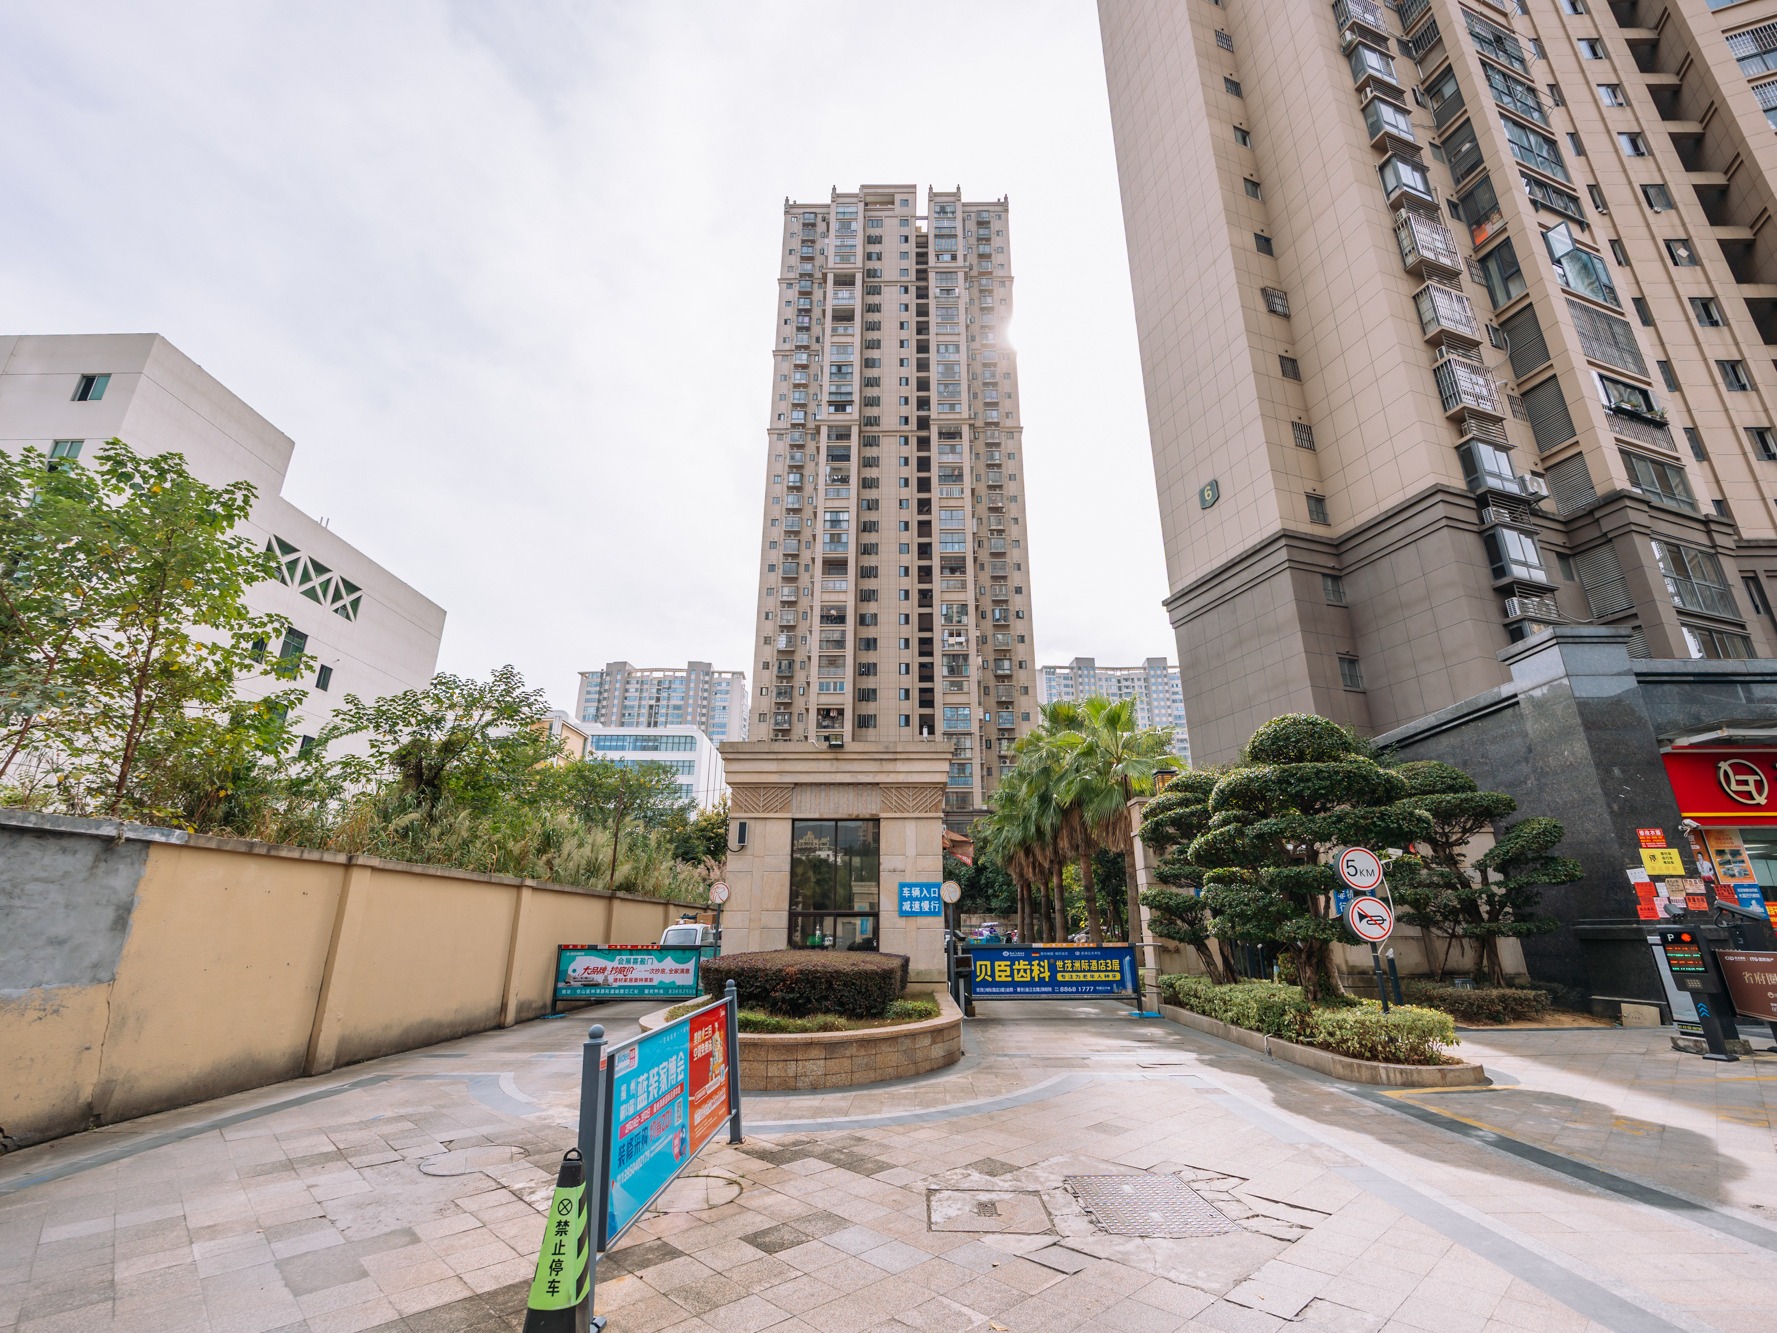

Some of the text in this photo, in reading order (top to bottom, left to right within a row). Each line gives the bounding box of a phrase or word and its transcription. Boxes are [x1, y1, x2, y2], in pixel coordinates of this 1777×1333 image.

[1204, 485, 1213, 501] 6
[902, 887, 939, 898] 车辆入口
[902, 900, 939, 912] 减速慢行
[1667, 933, 1675, 941] P
[975, 959, 1050, 982] 贝臣齿科
[1055, 959, 1120, 971] 世茂洲际酒店3层
[1060, 973, 1117, 981] 专注为老年人种牙
[637, 1051, 686, 1111] 蓝装家博会
[617, 1126, 649, 1169] 装修采购
[546, 1219, 570, 1297] 禁止停车
